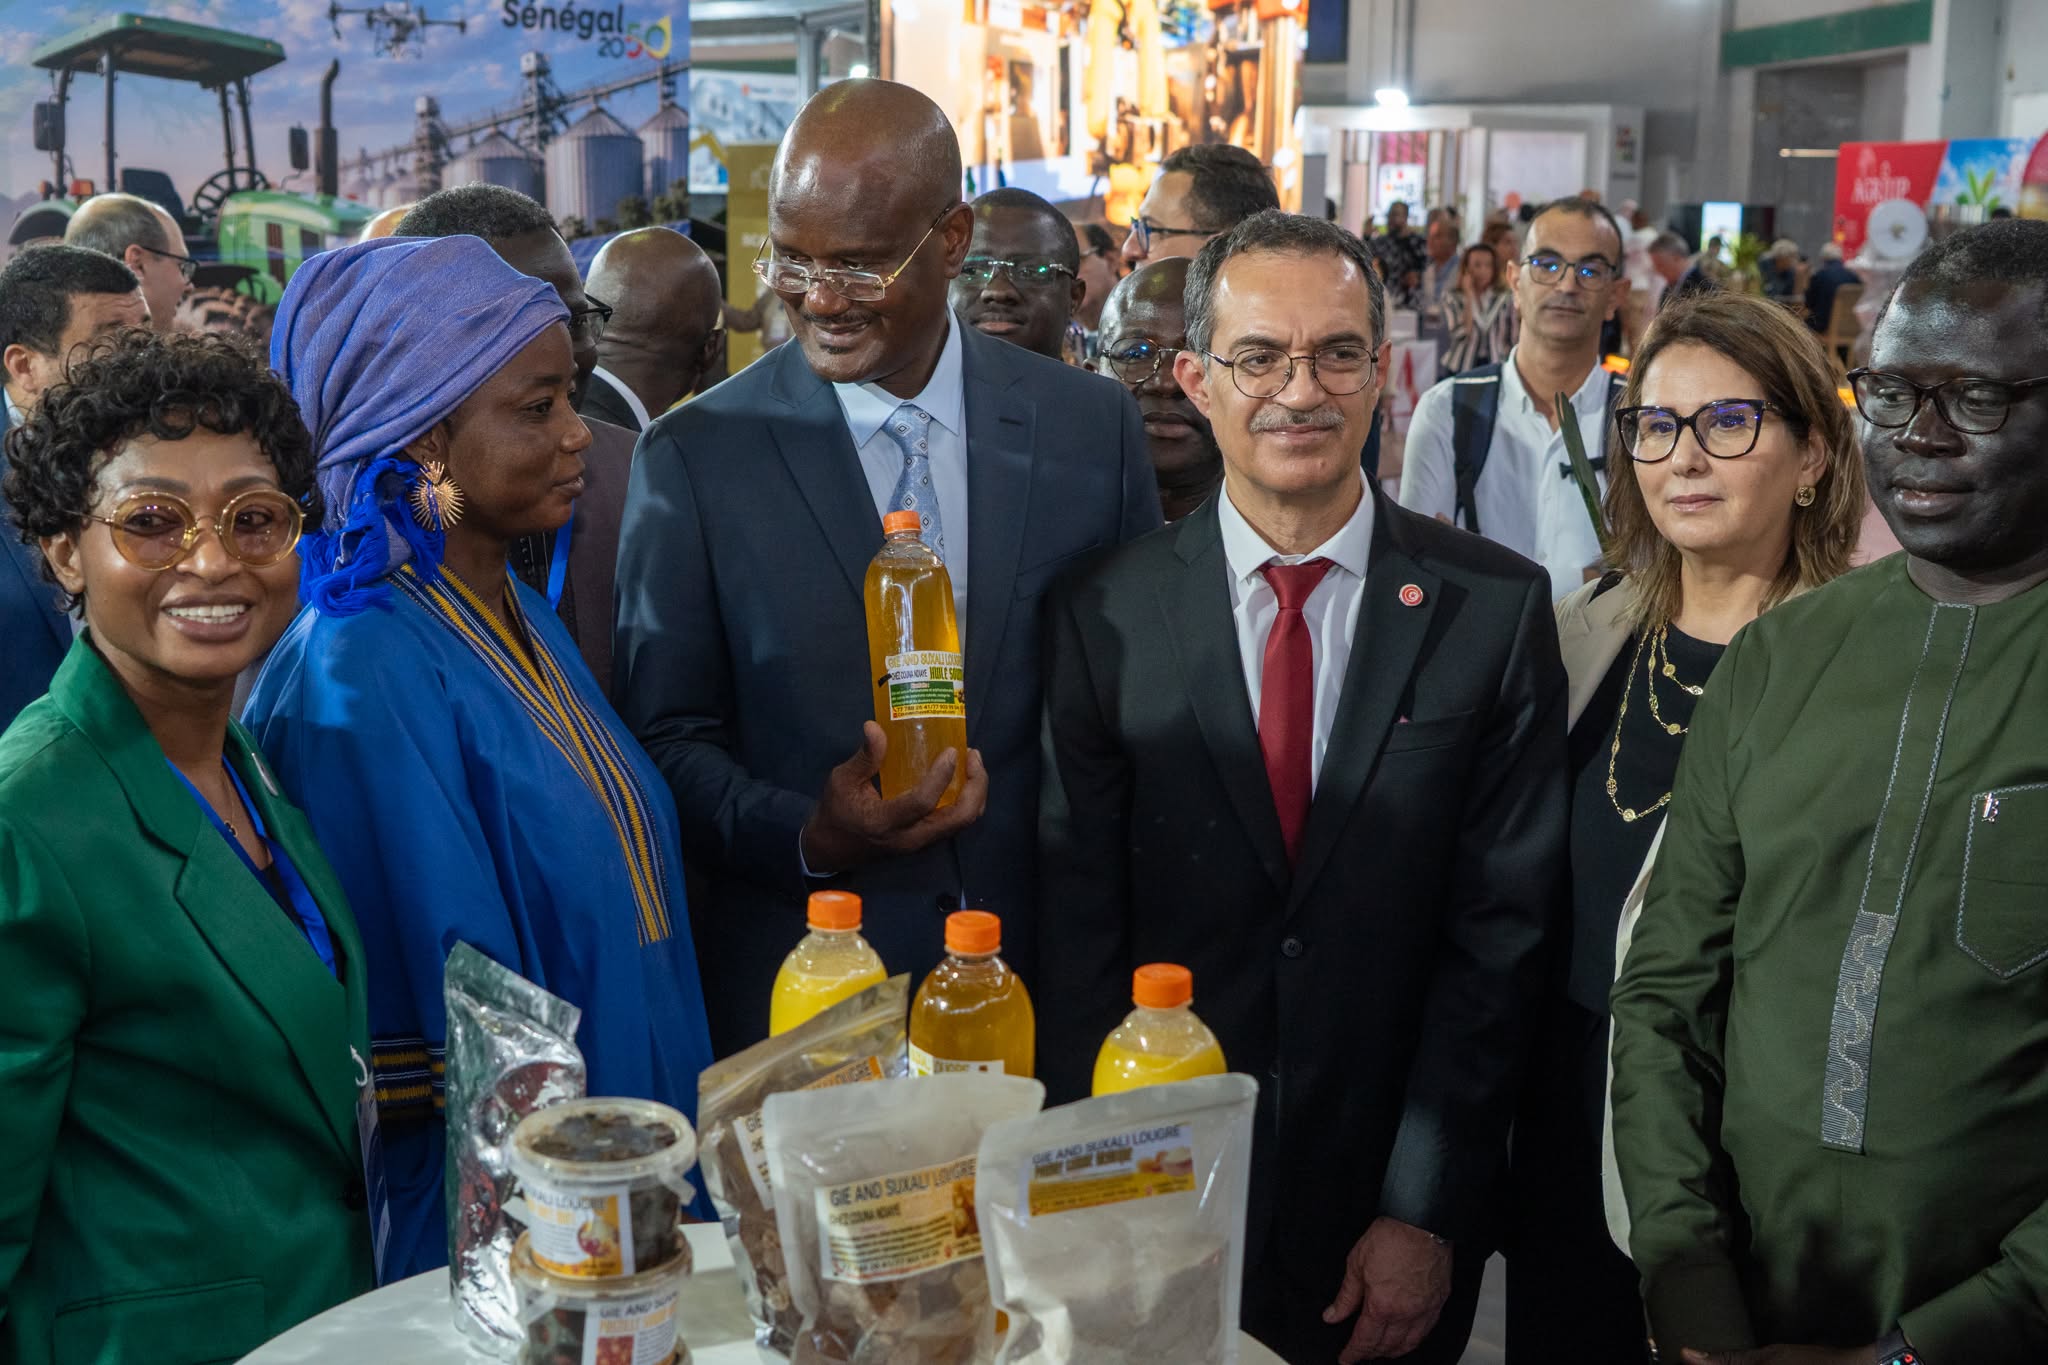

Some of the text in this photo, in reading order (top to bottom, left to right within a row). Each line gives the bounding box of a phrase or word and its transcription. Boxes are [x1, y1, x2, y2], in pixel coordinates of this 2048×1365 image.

[502, 0, 624, 40] Sénégal
[1055, 1144, 1082, 1158] AND
[831, 1189, 852, 1206] GIE
[855, 1180, 882, 1201] AND
